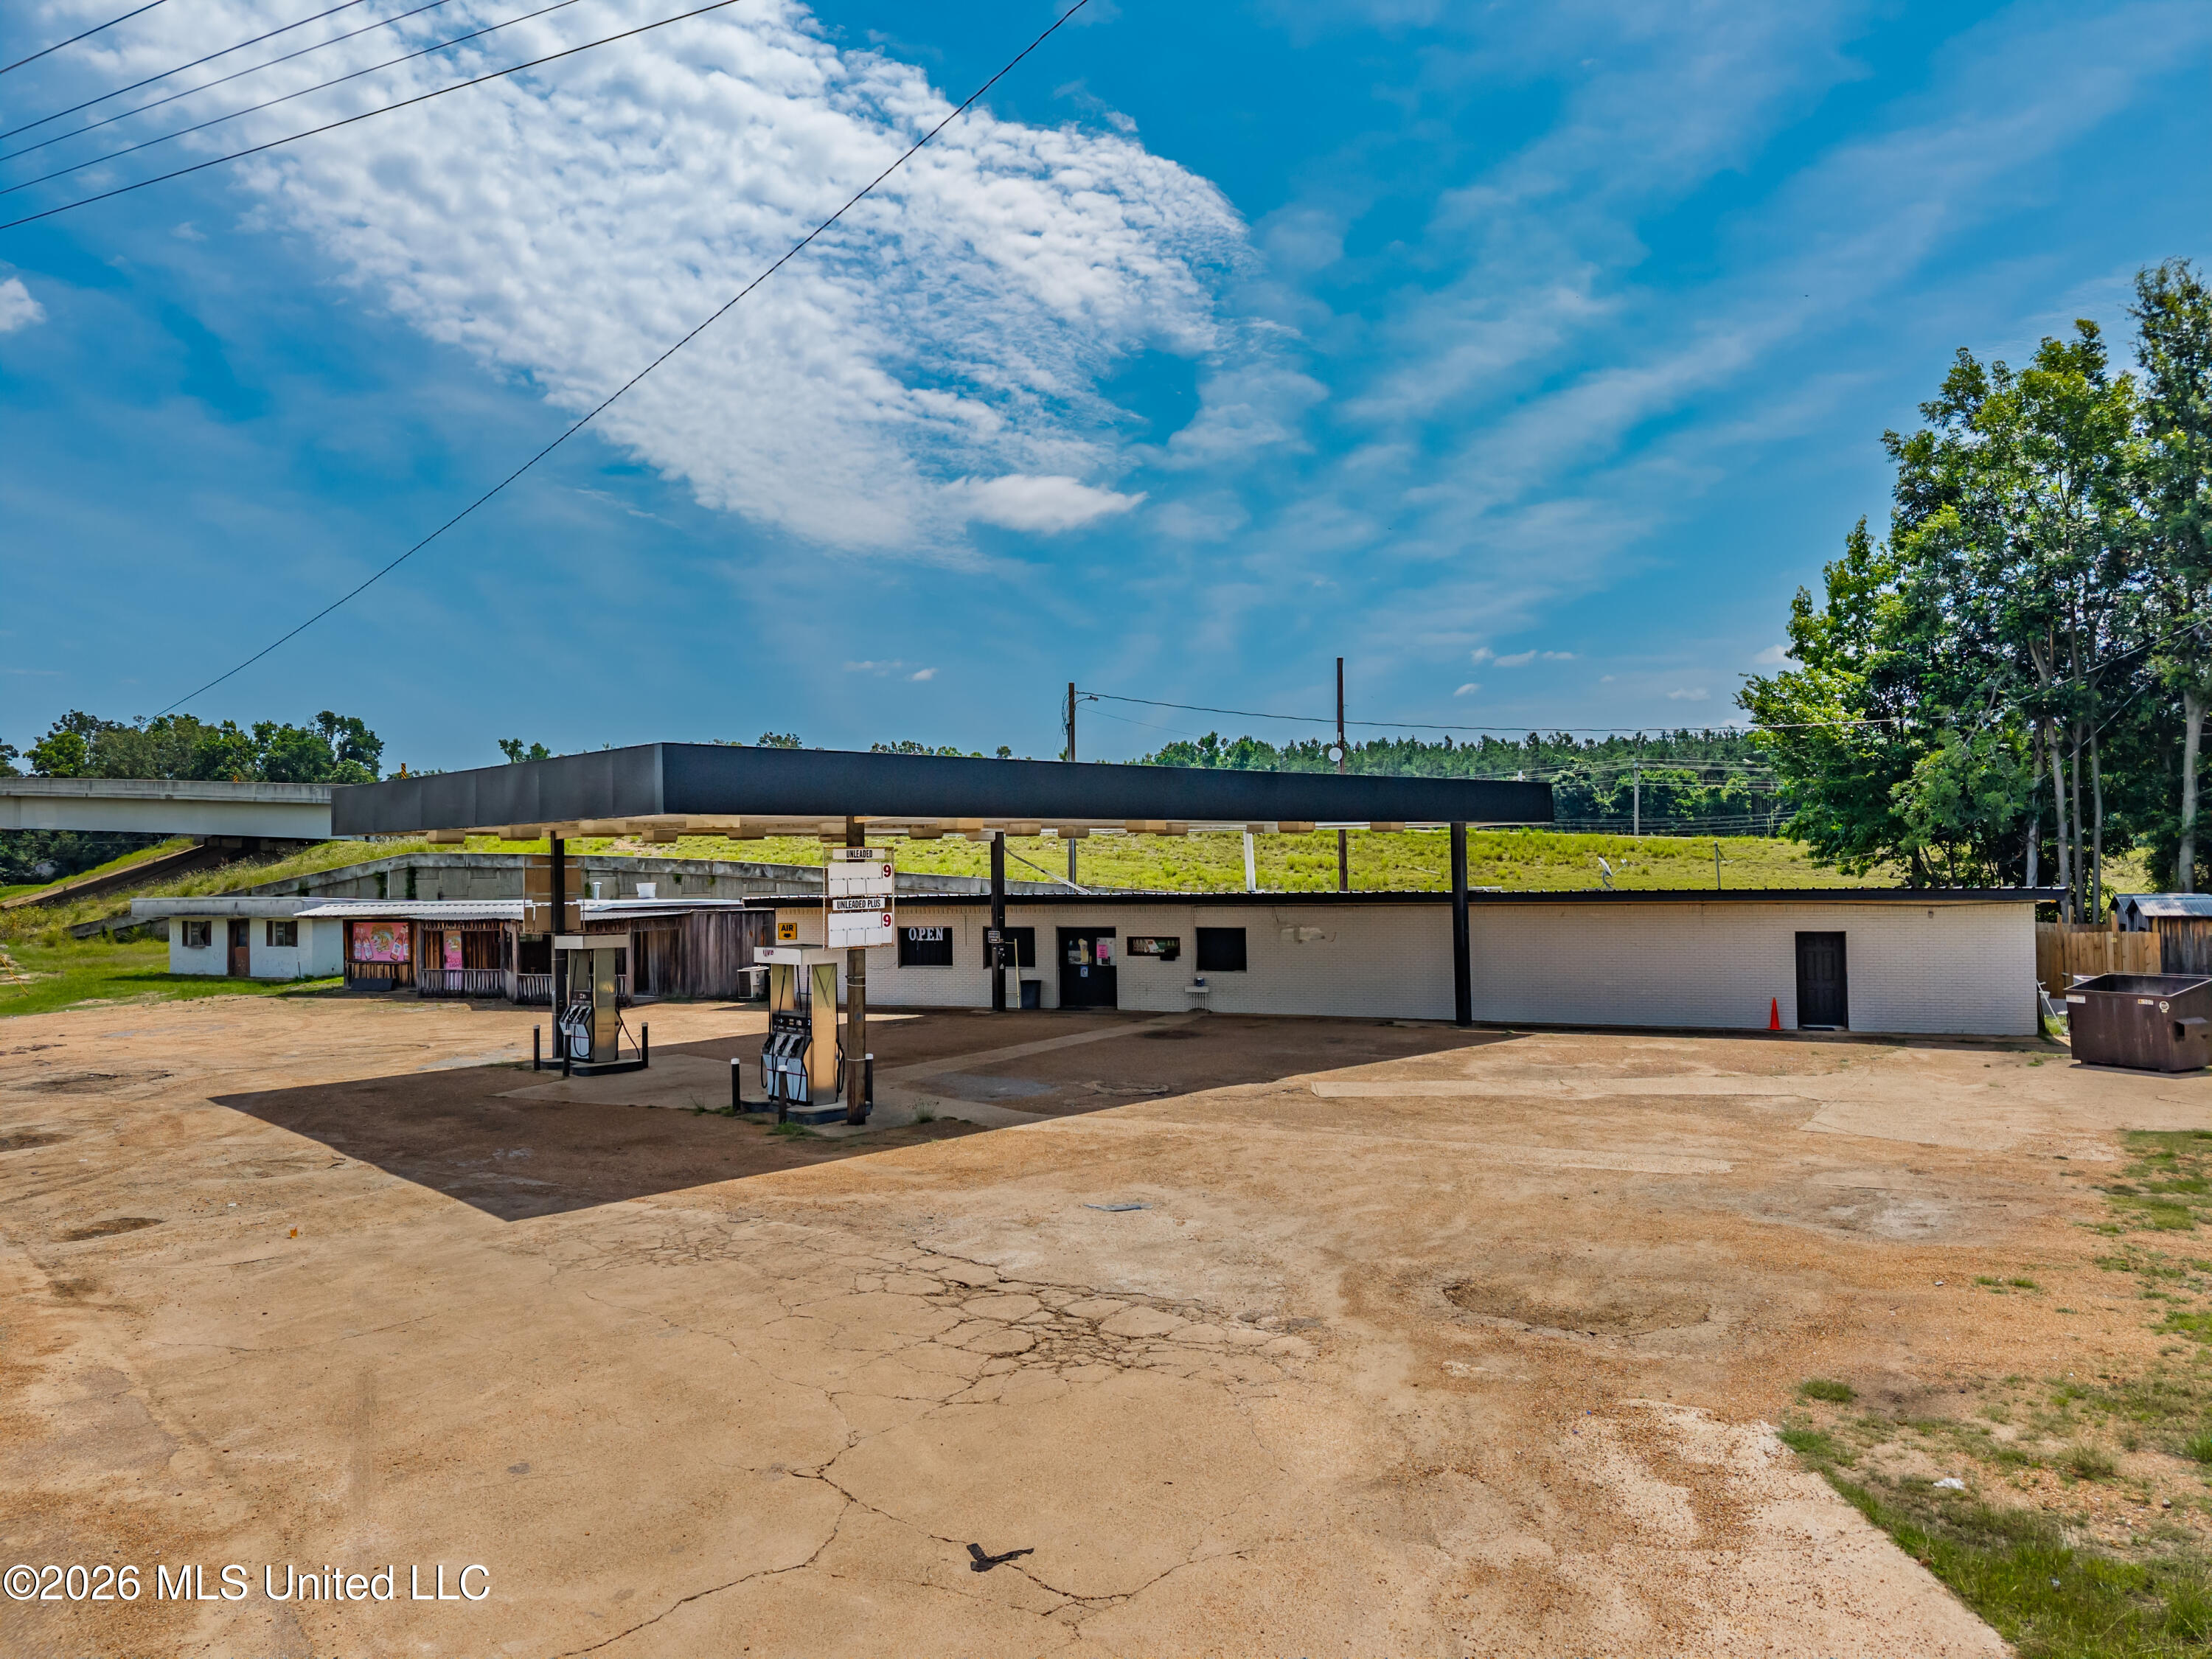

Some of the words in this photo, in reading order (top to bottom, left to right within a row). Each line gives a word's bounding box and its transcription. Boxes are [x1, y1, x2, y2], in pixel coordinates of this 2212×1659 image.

[846, 849, 873, 858] UNLEADED
[883, 864, 891, 877] 9
[837, 900, 866, 909] UNLEADED
[867, 899, 881, 908] PLUS
[883, 914, 891, 928] 9
[908, 926, 944, 941] OPEN
